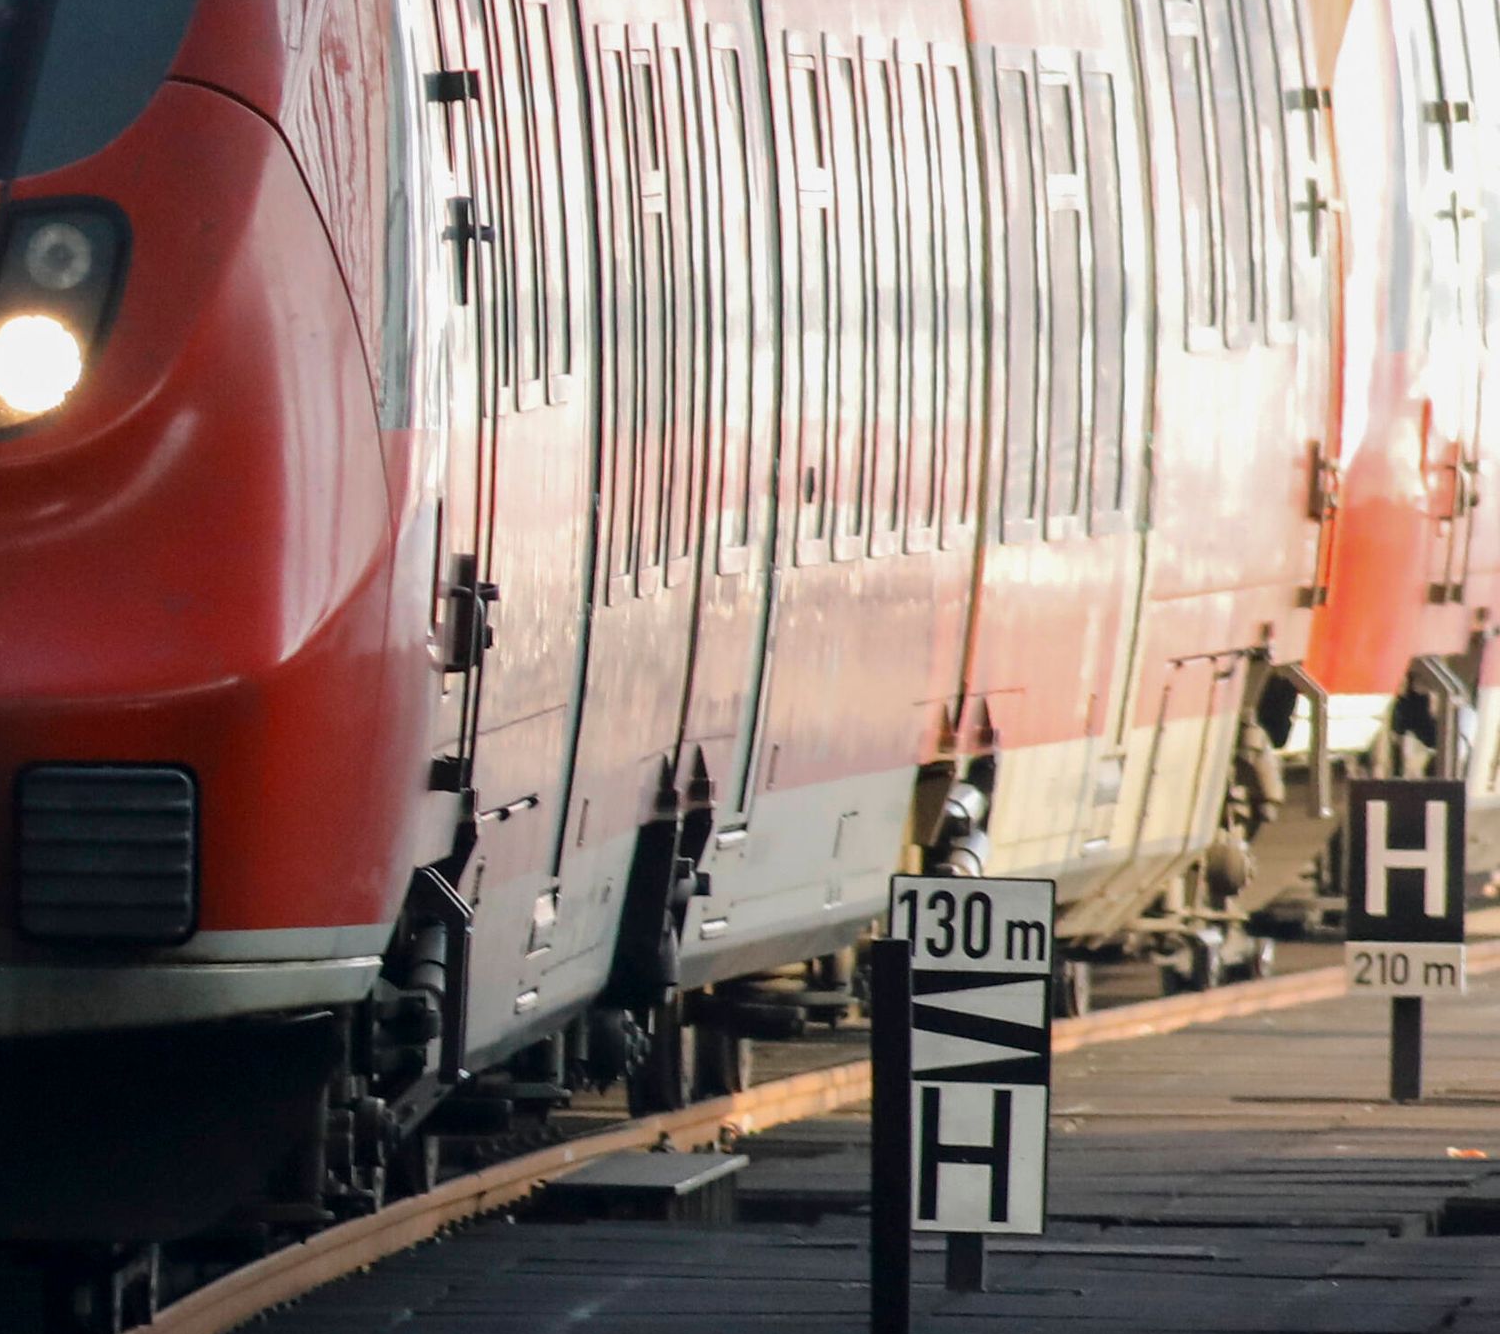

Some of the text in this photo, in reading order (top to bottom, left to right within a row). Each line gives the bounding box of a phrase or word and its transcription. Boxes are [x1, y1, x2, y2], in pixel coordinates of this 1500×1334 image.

[1365, 799, 1447, 917] H
[898, 889, 1046, 962] 130 m
[1354, 951, 1456, 986] 210 m
[918, 1086, 1013, 1224] H
